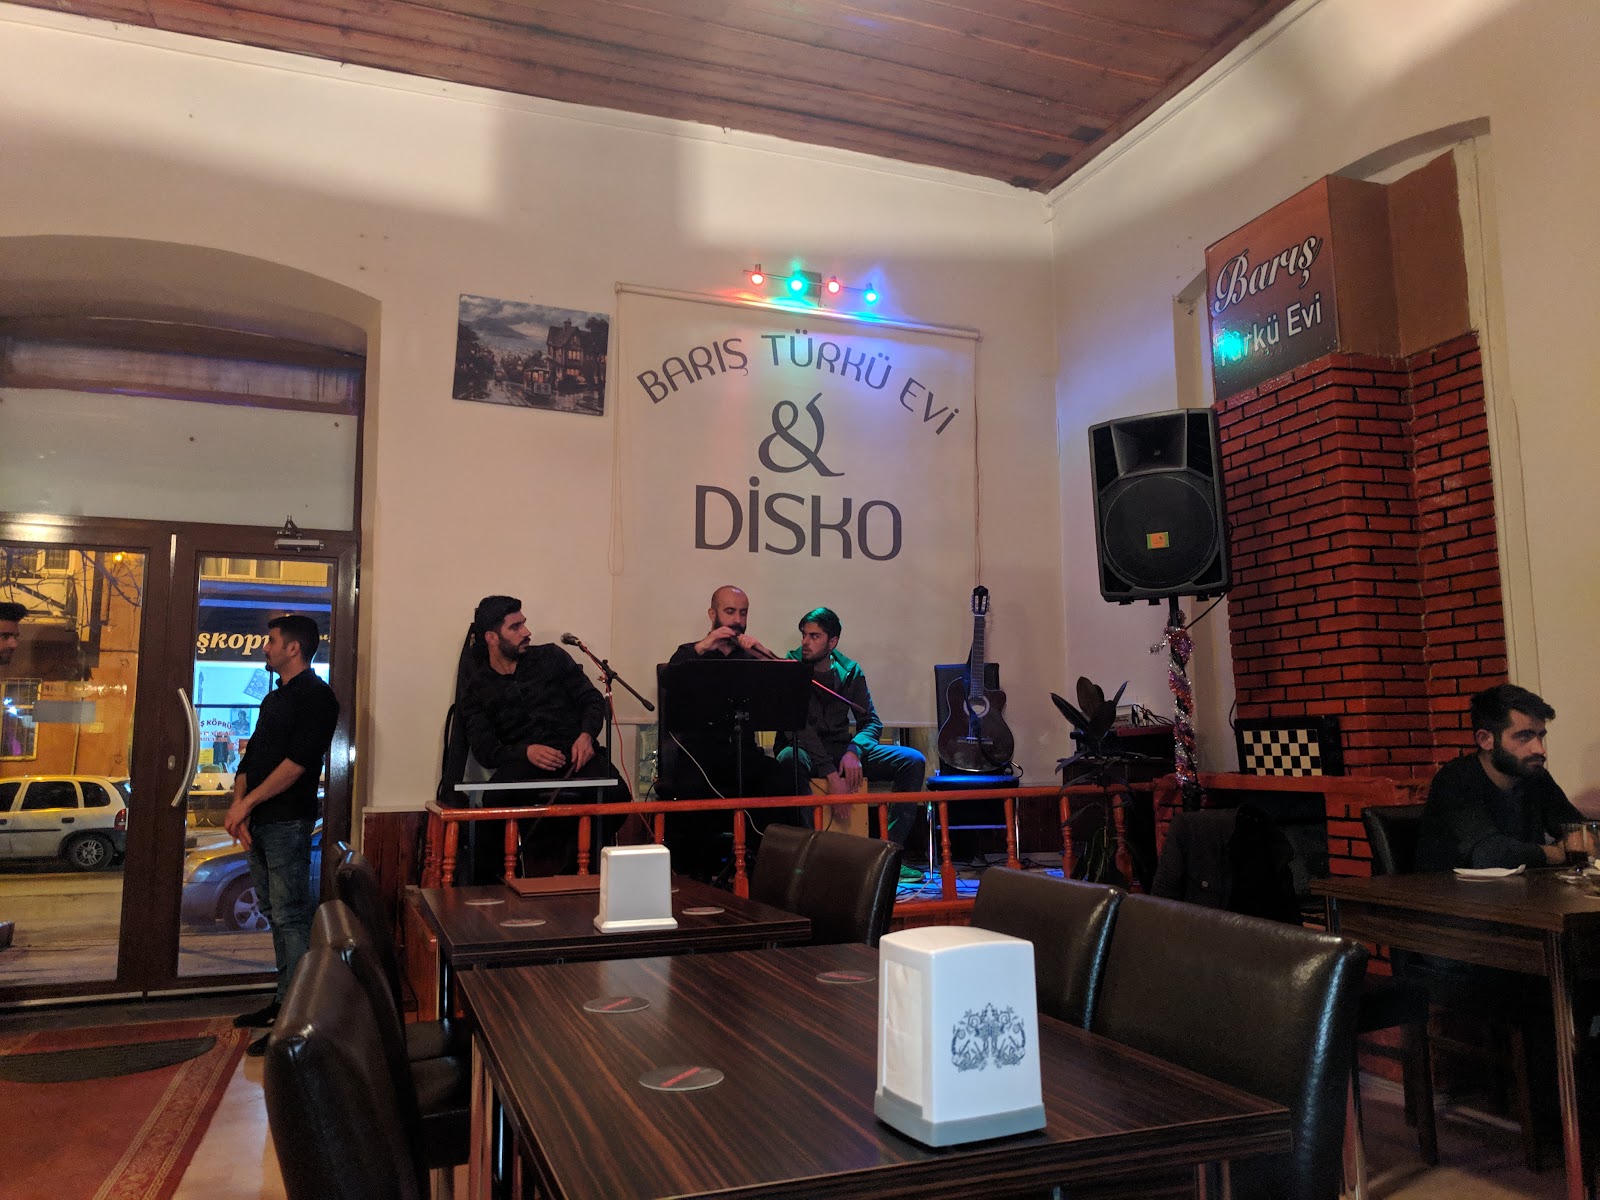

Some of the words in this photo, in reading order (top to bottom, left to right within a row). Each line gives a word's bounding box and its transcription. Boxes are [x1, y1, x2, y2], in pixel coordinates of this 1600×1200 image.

[1214, 236, 1322, 313] Barış
[1217, 314, 1280, 366] rkü
[1287, 293, 1322, 338] Evi
[637, 338, 748, 404] BARIŞ
[761, 329, 893, 390] TÜRKÜ
[899, 377, 960, 435] EVİ
[758, 392, 845, 477] &
[694, 476, 902, 561] DİSKO
